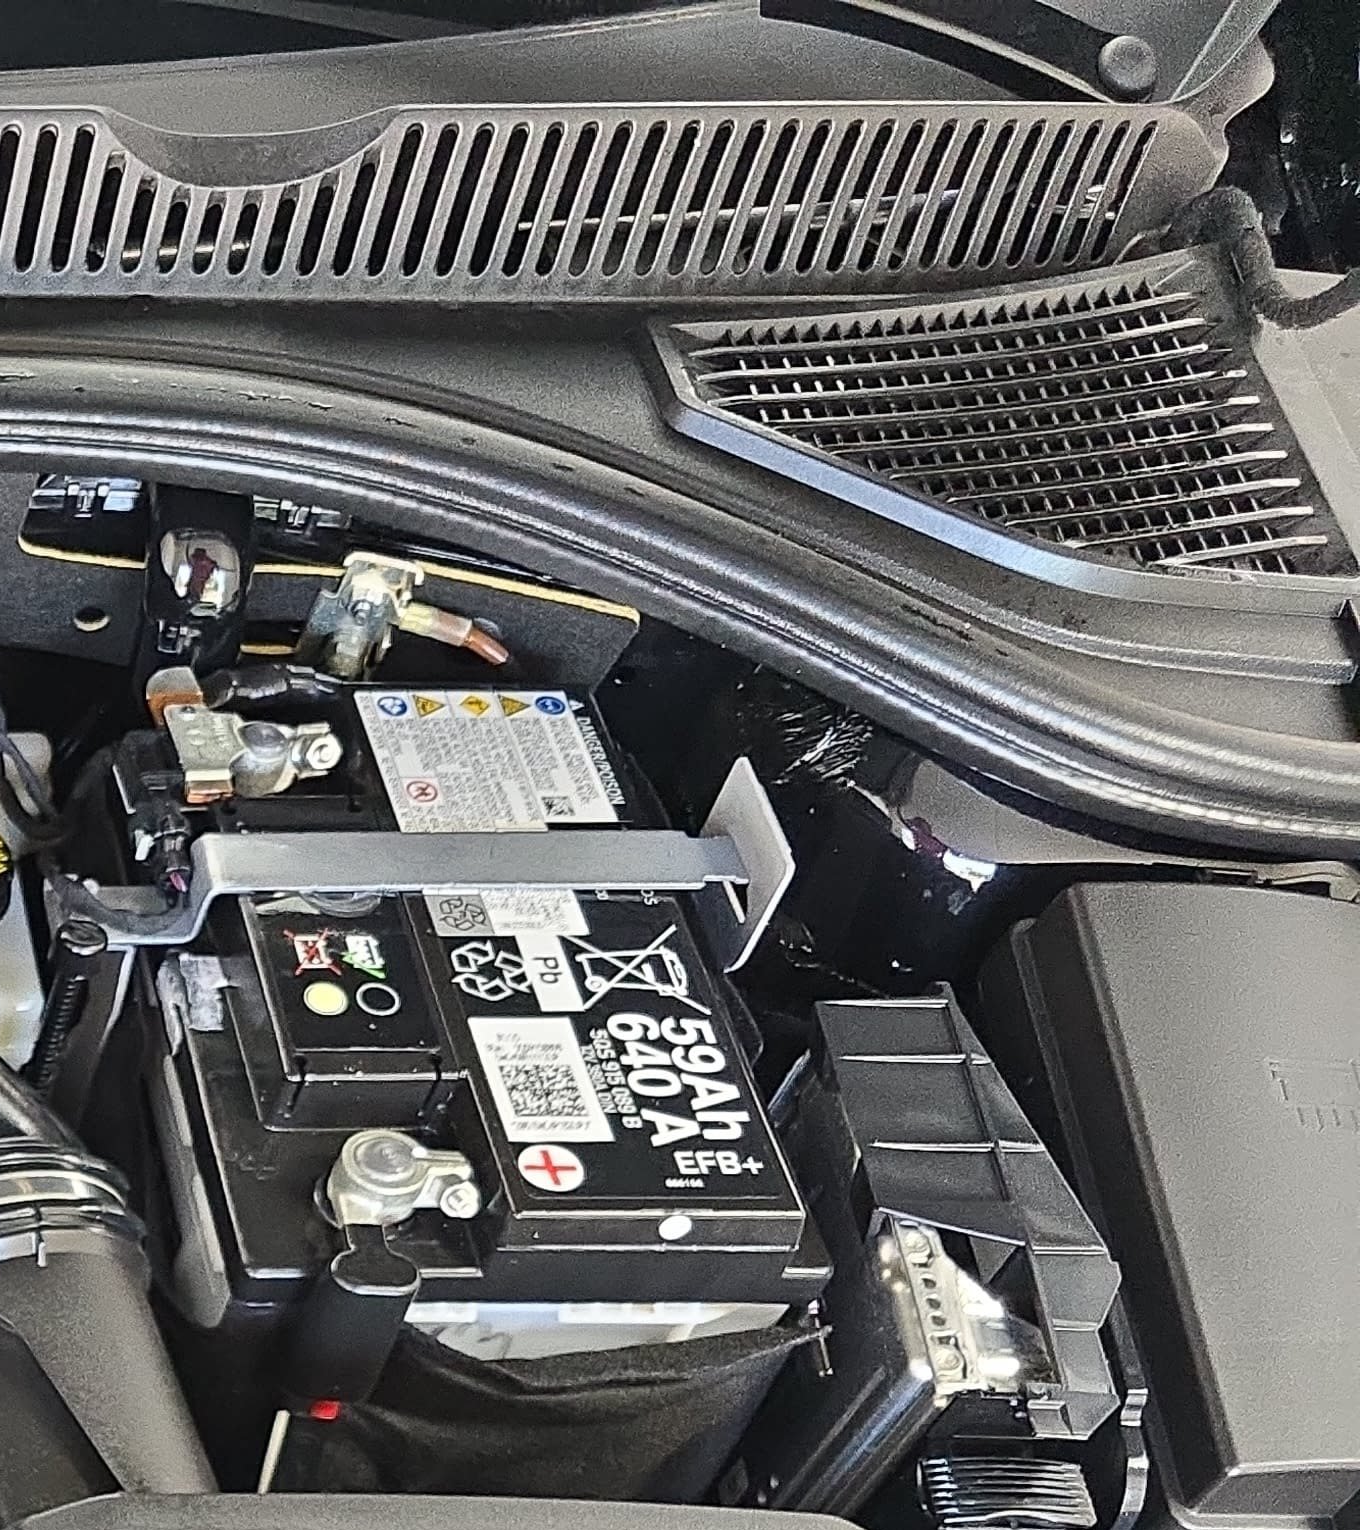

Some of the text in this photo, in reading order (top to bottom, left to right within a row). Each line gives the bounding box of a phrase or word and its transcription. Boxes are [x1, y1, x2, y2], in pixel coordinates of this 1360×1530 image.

[577, 716, 626, 806] DANGER/POISON
[532, 956, 563, 985] Pb
[606, 1012, 682, 1098] 640
[660, 1015, 751, 1141] 59Ah
[601, 1060, 626, 1086] 915
[621, 1115, 644, 1129] B
[640, 1108, 702, 1147] A
[673, 1150, 765, 1175] EFB+
